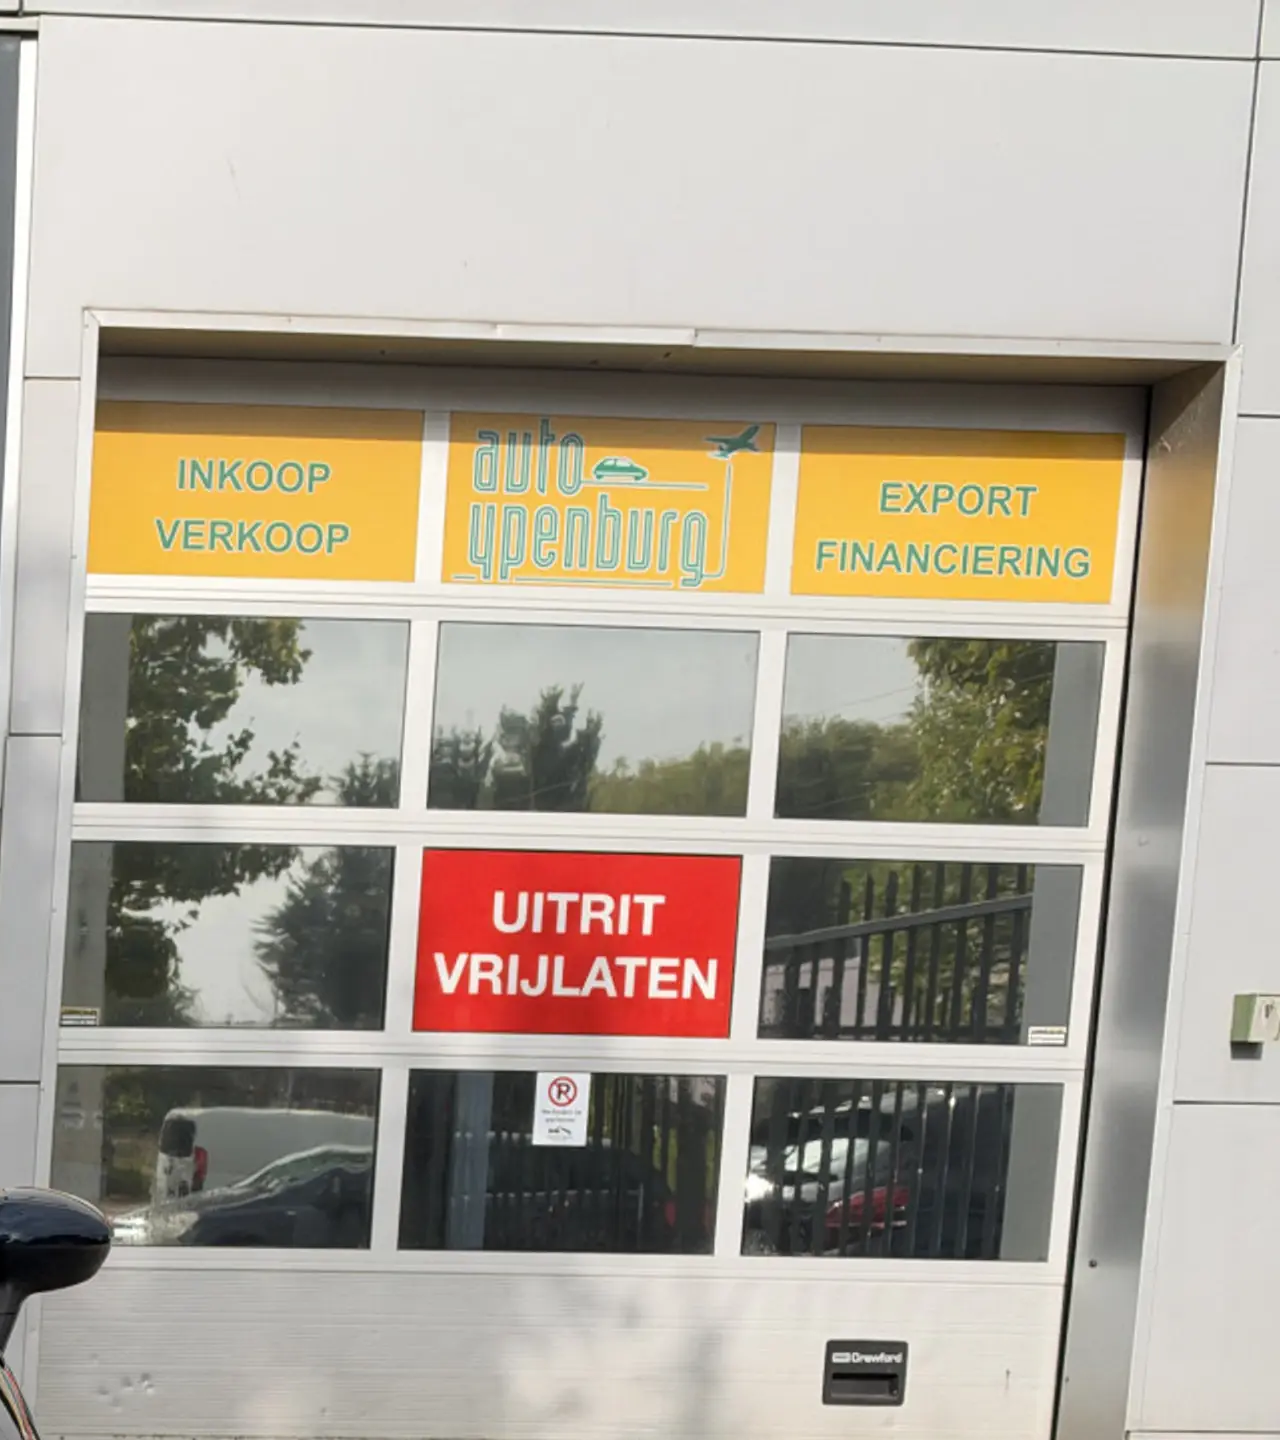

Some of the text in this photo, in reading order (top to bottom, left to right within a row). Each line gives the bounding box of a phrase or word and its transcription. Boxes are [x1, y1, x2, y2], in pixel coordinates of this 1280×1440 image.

[177, 458, 331, 493] INKOOP
[472, 417, 585, 496] auto
[878, 481, 1037, 518] EXPORT
[156, 518, 351, 555] VERKOOP
[468, 490, 709, 587] ypenburg
[815, 540, 1091, 579] FINANCIERING
[491, 889, 666, 939] UITRIT
[433, 952, 719, 1001] VRIJLATEN
